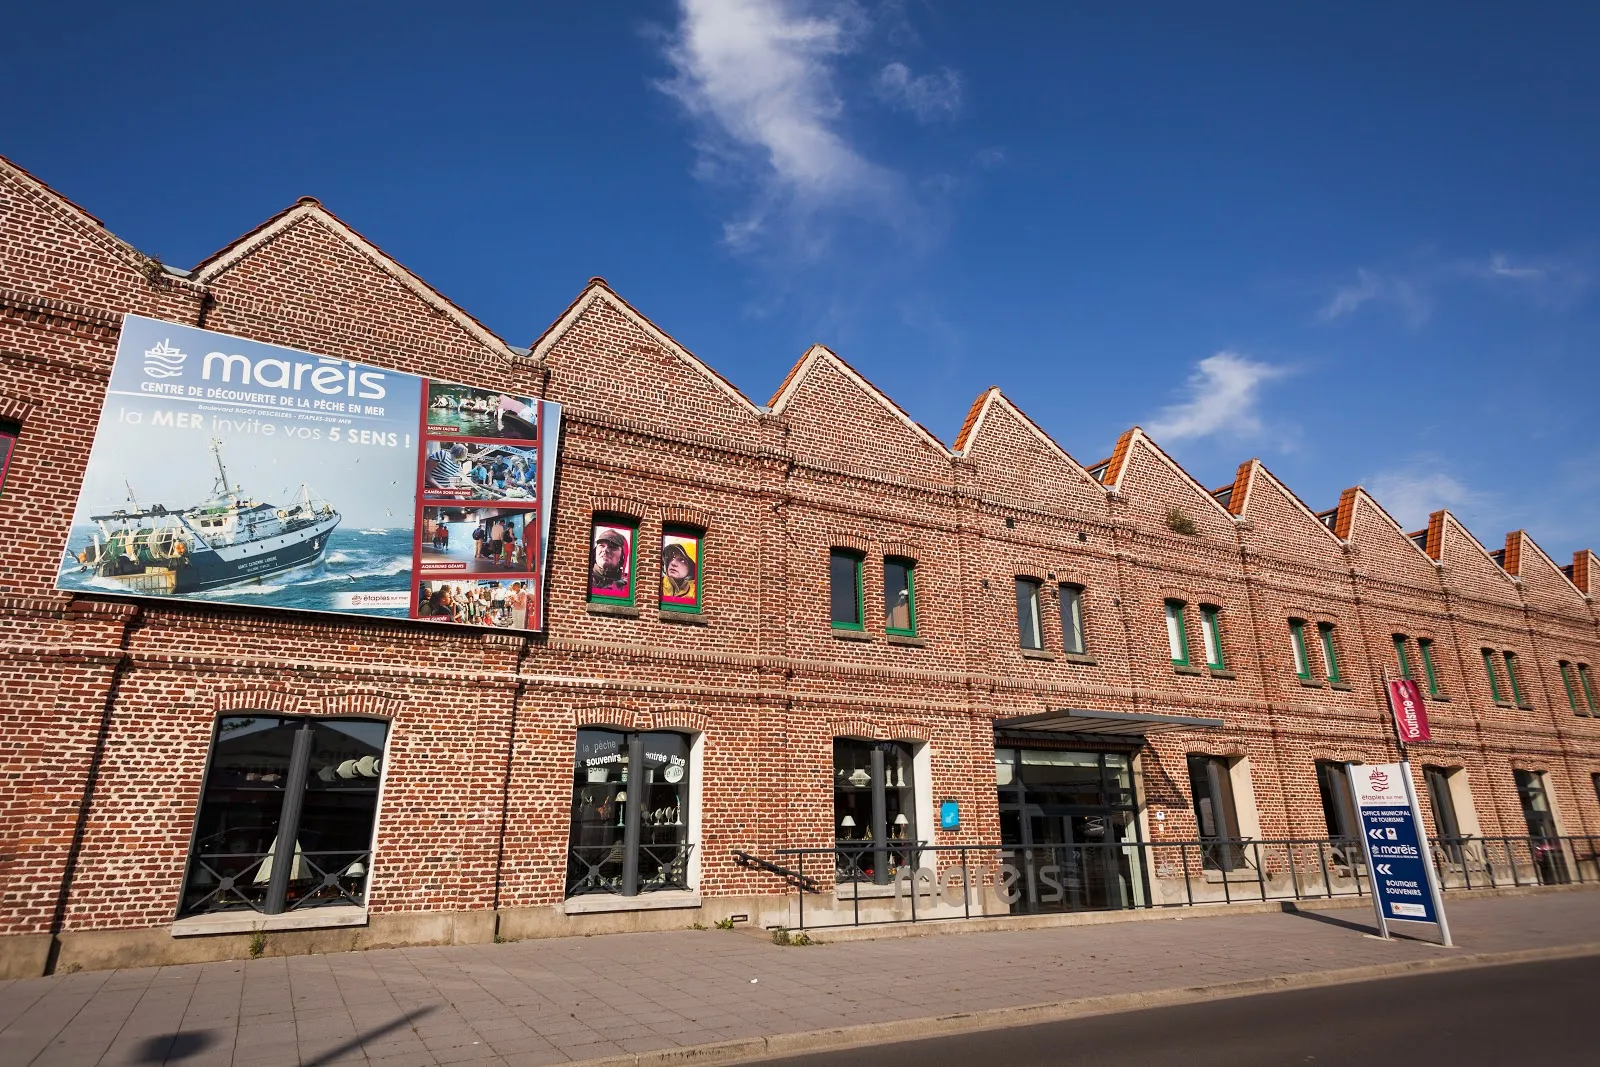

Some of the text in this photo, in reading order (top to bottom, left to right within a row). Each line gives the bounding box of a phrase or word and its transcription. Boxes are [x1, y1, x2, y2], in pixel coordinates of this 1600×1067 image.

[140, 381, 385, 416] CENTRE DE DÉCOUVERTE DE LA PÊCHE EN MER
[198, 404, 234, 413] Boulevard
[118, 407, 142, 424] la
[152, 410, 204, 430] MER
[212, 414, 276, 436] invite
[284, 424, 322, 440] vos
[328, 427, 341, 442] 5
[347, 428, 398, 447] SENS
[1402, 700, 1421, 739] tourisme
[582, 743, 590, 753] la
[586, 752, 622, 767] souvenirs
[645, 751, 686, 767] entrée libre
[1385, 879, 1418, 888] BOUTIQUE
[1385, 887, 1422, 896] SOUVENIRS
